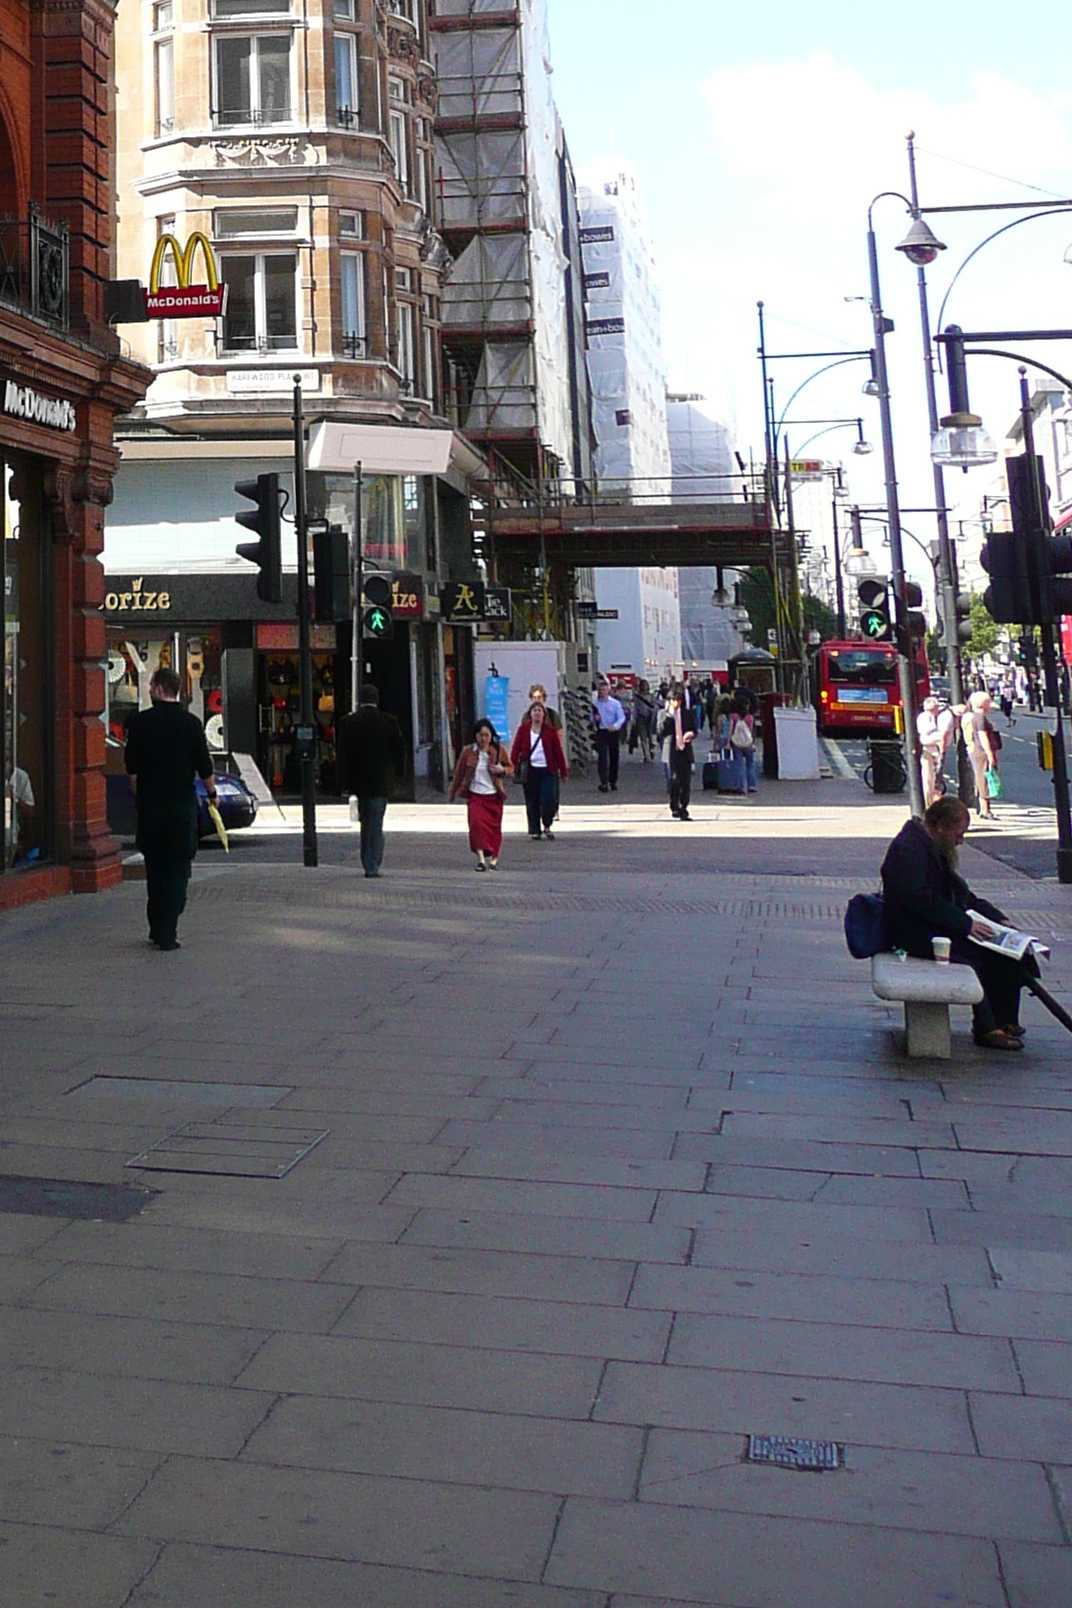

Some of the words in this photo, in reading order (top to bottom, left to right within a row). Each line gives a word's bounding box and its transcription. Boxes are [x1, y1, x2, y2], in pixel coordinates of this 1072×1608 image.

[147, 294, 220, 308] McDonald's
[4, 379, 77, 432] McDonald's
[98, 577, 171, 610] orize
